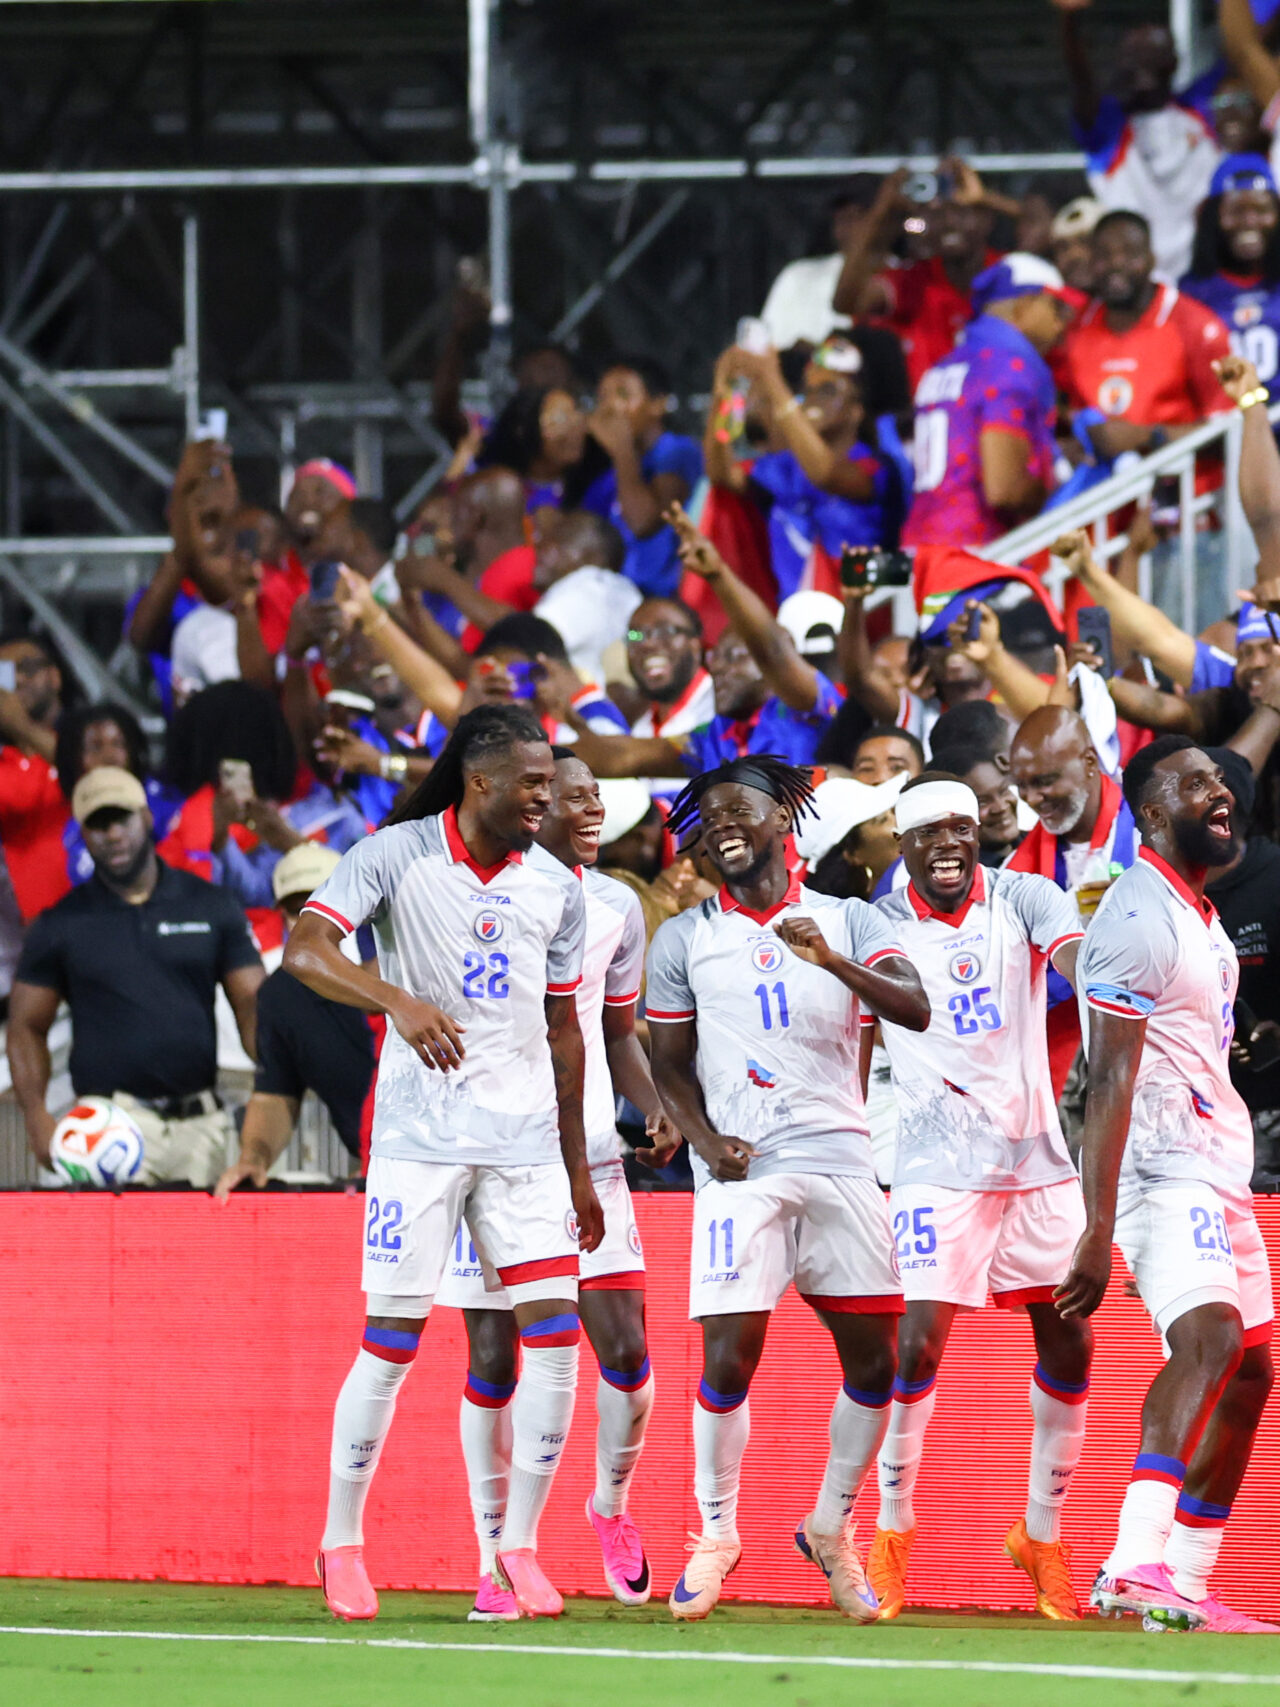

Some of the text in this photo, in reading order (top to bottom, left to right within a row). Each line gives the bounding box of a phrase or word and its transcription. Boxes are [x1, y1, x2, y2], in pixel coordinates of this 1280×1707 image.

[468, 894, 511, 904] SAETA
[463, 951, 509, 998] 22
[754, 982, 789, 1030] 11
[948, 986, 1002, 1035] 25
[367, 1197, 402, 1249] 22
[709, 1218, 734, 1268] 11
[894, 1207, 937, 1258] 25
[701, 1272, 740, 1283] SAETA
